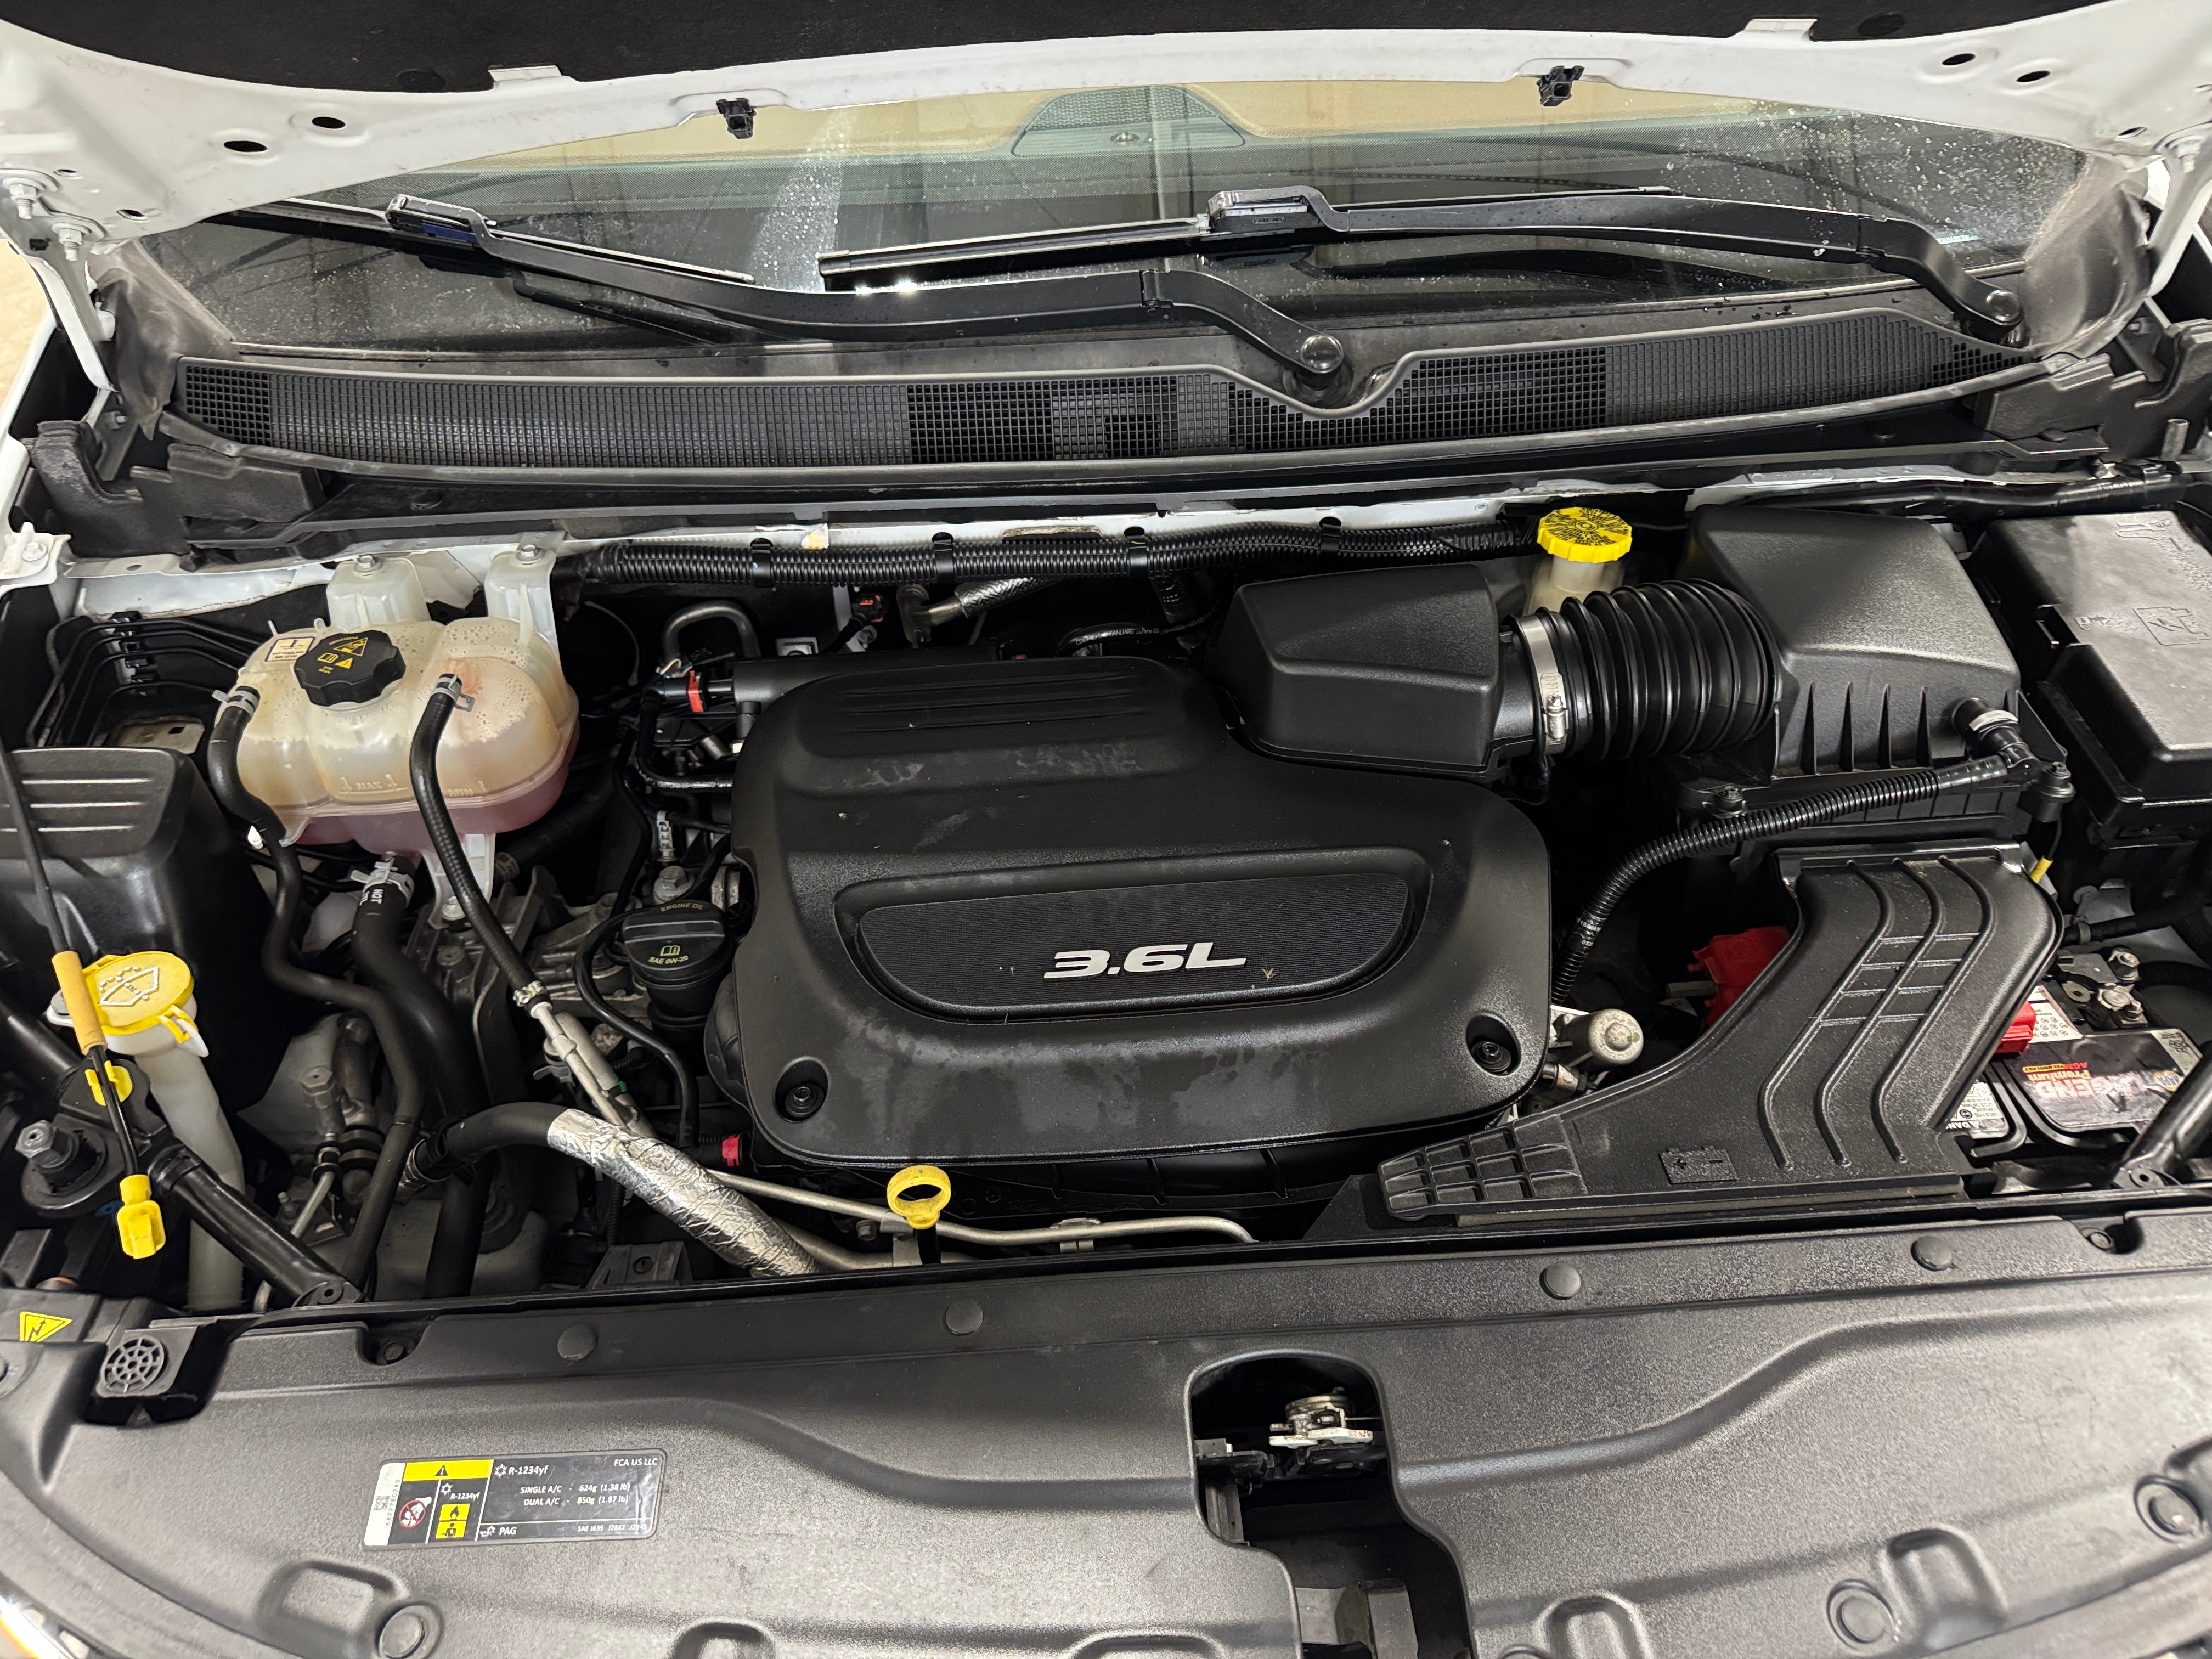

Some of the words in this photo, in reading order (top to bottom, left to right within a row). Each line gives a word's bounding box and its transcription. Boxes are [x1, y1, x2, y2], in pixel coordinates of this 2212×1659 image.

[1103, 628, 1134, 639] TANDARD
[356, 781, 383, 791] MAX
[371, 889, 384, 905] HOT
[661, 902, 691, 912] ENGINE
[648, 956, 665, 964] SAE
[665, 955, 689, 964] 0W-20
[1043, 942, 1246, 980] 3.6L
[2027, 1069, 2091, 1082] Premium
[631, 1458, 642, 1466] US
[644, 1458, 658, 1466] LLC
[508, 1465, 549, 1476] R-1234yf
[520, 1486, 546, 1494] SINGLE
[548, 1485, 562, 1493] A/C
[579, 1484, 597, 1492] 624g
[600, 1483, 619, 1492] (1.38
[620, 1482, 630, 1491] lb)
[450, 1491, 481, 1501] R-1234yf
[545, 1497, 560, 1506] A/C
[577, 1497, 595, 1505] 850g
[598, 1496, 617, 1505] (1.87
[618, 1495, 629, 1504] lb)
[386, 1479, 400, 1526] 68227802AD
[499, 1526, 517, 1535] PAG
